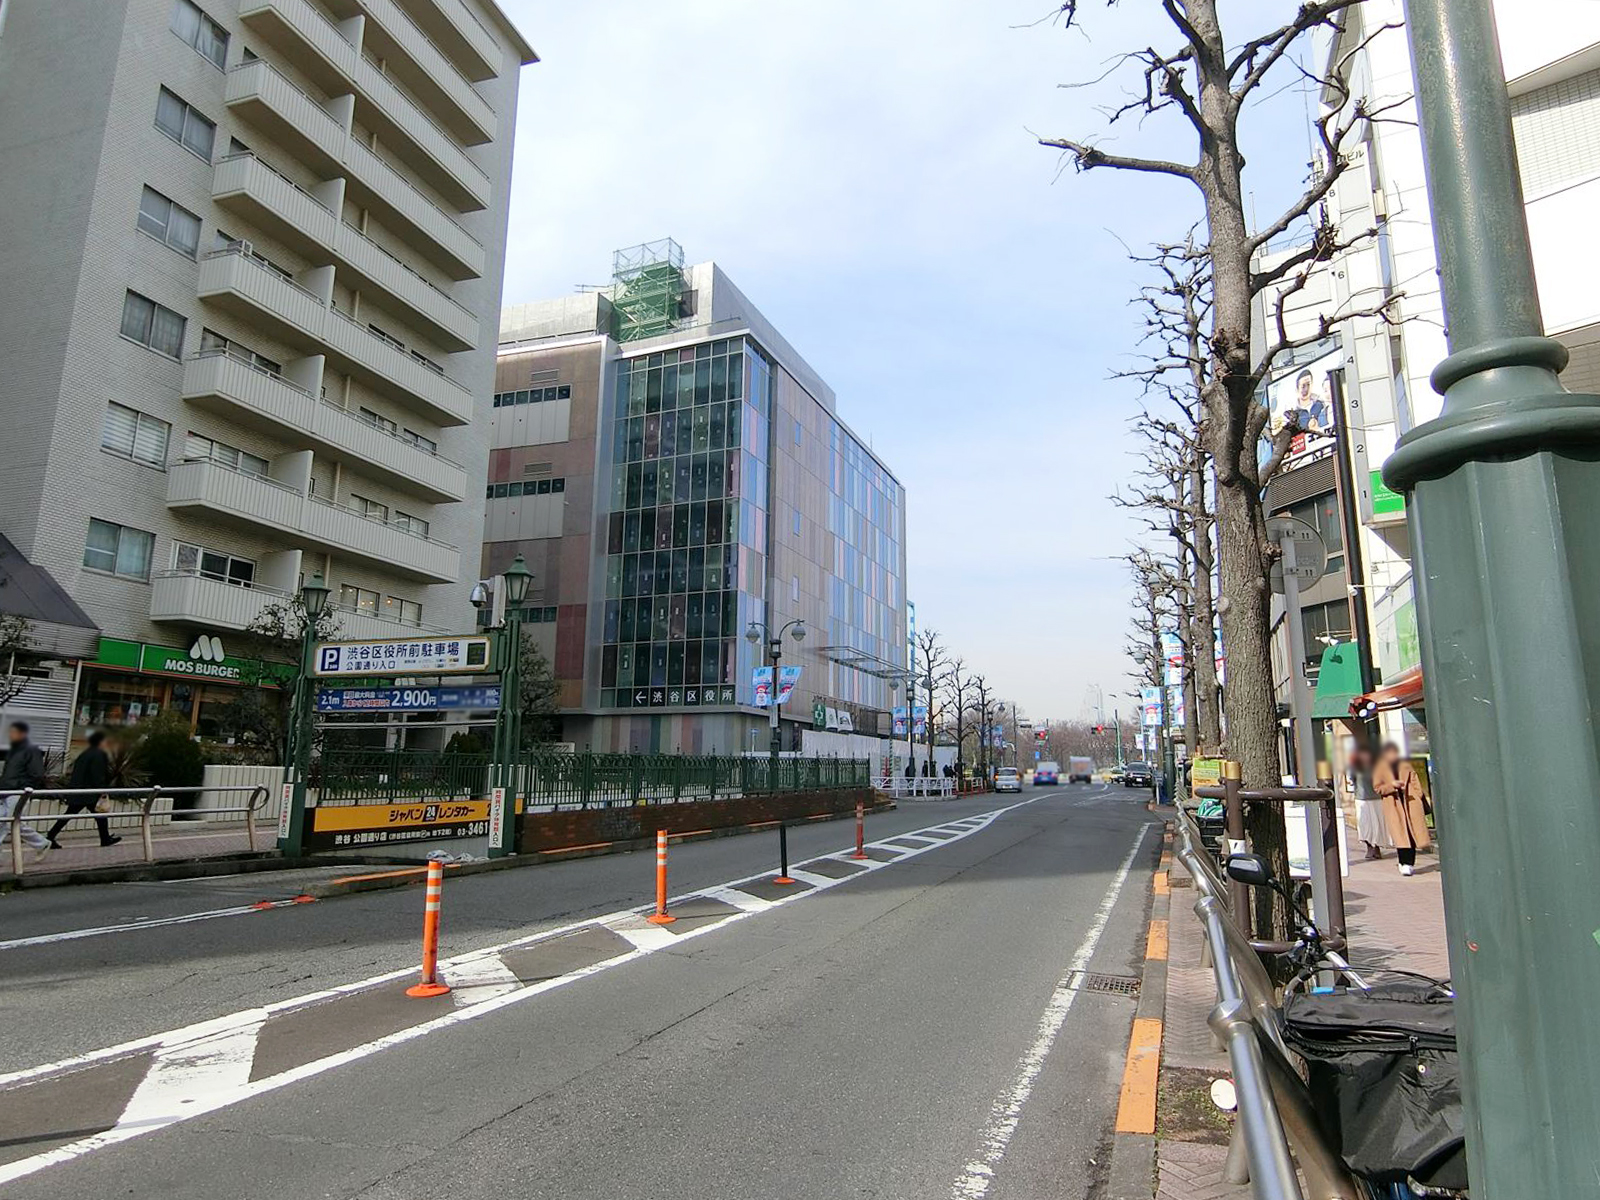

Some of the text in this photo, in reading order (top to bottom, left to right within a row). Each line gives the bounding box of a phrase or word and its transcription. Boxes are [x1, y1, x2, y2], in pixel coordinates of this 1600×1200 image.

[1329, 189, 1336, 198] 8
[1337, 270, 1345, 280] 6
[1347, 355, 1354, 364] 4
[1351, 400, 1359, 409] 3
[1356, 444, 1364, 453] 2
[1363, 490, 1368, 499] 1
[347, 641, 460, 660] 渋谷区役所前駐車場
[324, 649, 338, 669] P
[164, 659, 194, 673] MOS
[346, 660, 396, 671] 公園通り入口
[321, 695, 340, 705] 2.1m
[652, 689, 733, 703] 渋谷区役所
